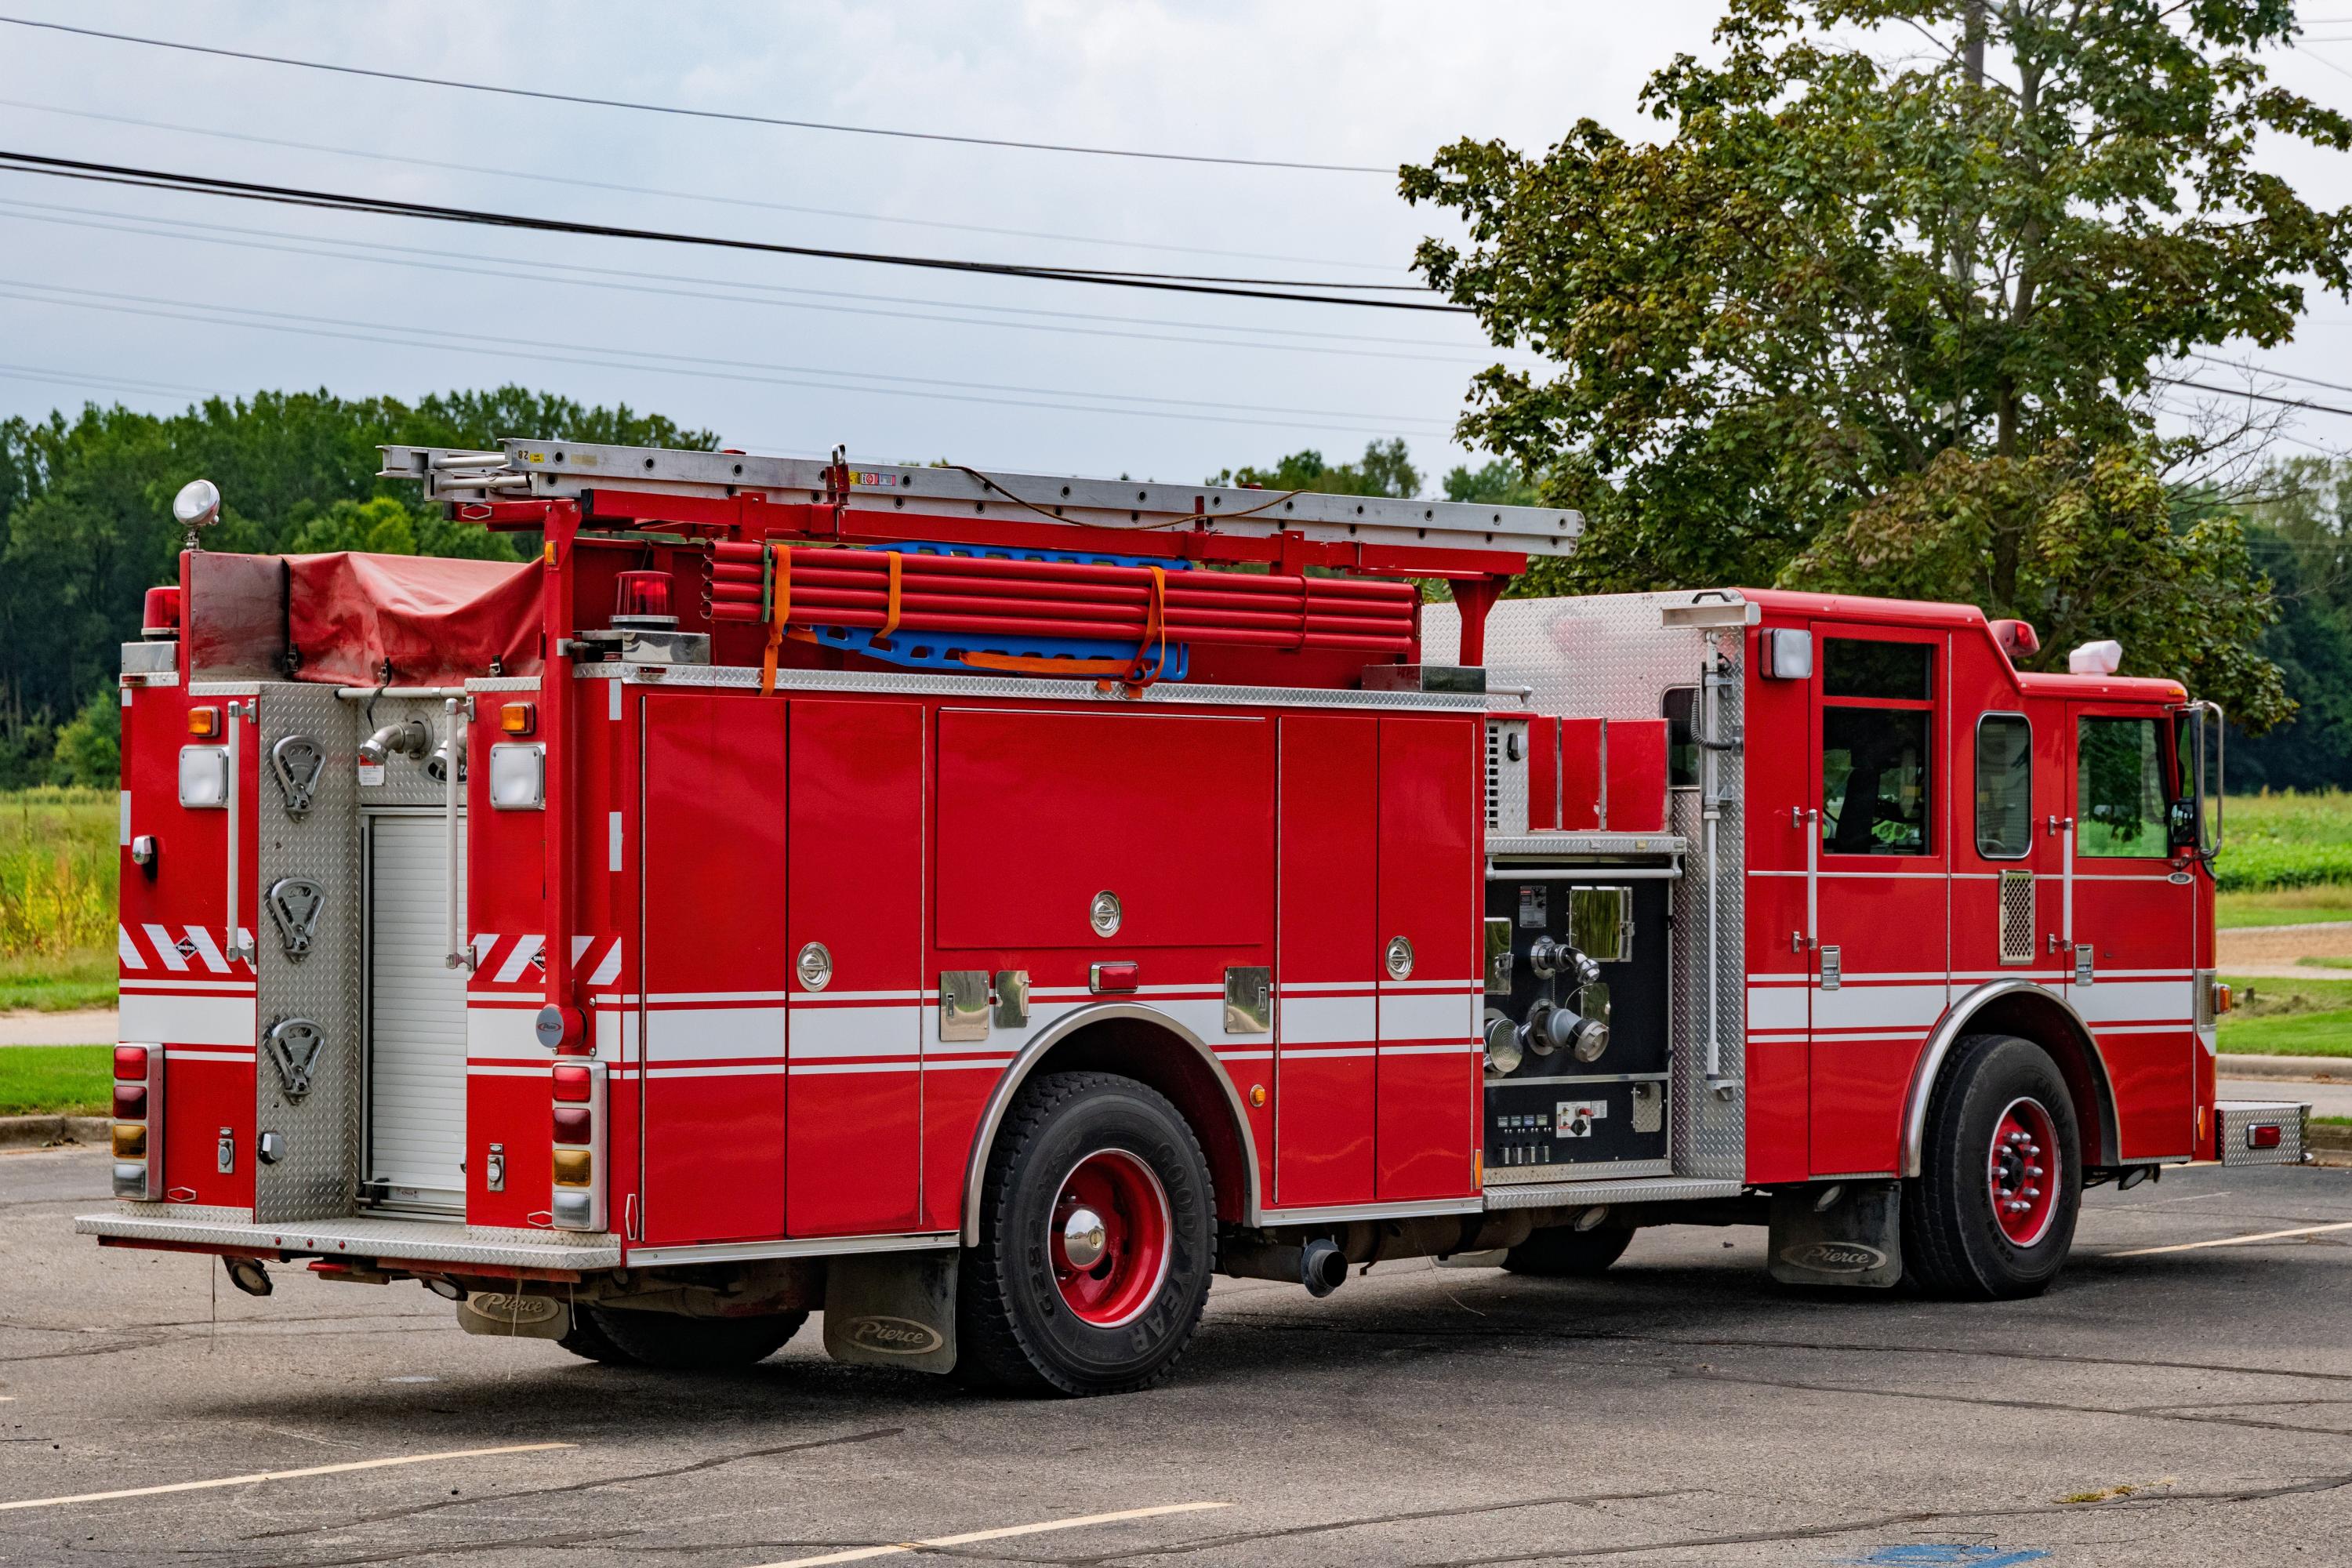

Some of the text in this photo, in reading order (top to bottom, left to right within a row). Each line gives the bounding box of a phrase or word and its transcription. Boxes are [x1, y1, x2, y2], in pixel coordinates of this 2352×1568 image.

[1801, 1247, 1869, 1263] Pierce
[484, 1292, 543, 1312] Pierce
[855, 1320, 924, 1344] Pierce
